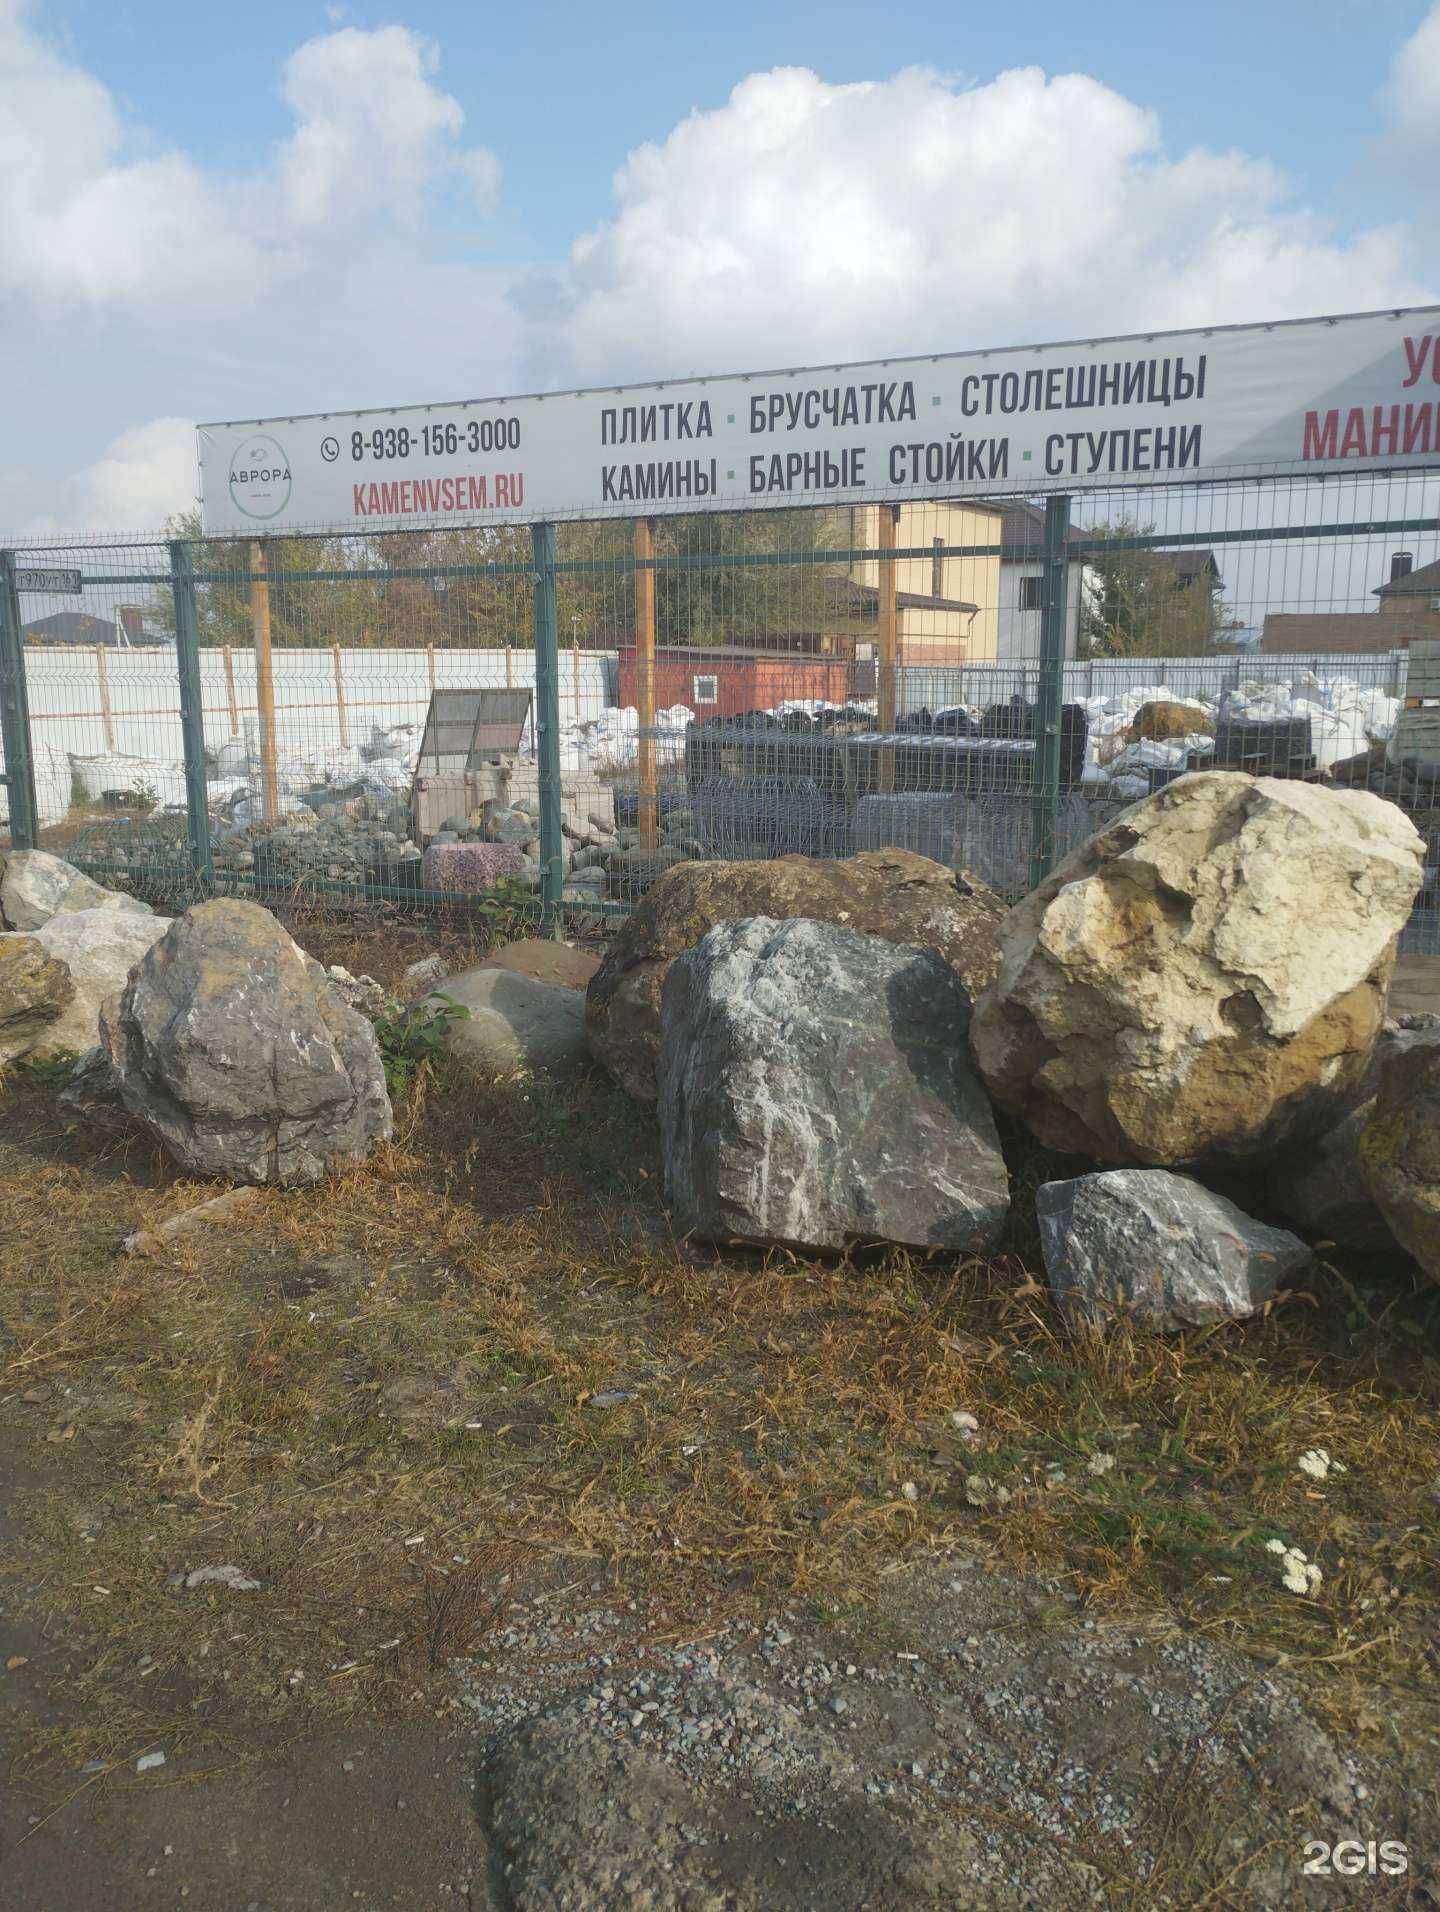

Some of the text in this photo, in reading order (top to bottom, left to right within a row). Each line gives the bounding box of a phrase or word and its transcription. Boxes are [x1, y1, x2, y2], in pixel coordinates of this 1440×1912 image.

[601, 354, 1207, 445] ПЛИТКА БРУСЧАТКА СТОЛЕШНИЦЫ
[351, 417, 521, 462] 8-938-156-3000
[1303, 401, 1440, 461] МАНИ
[229, 468, 292, 484] АВРОРА
[602, 424, 1202, 502] КАМИНЫ БАРНЫЕ СТОЙКИ СТУПЕНИ
[353, 472, 525, 516] KAMENVSEM.RU
